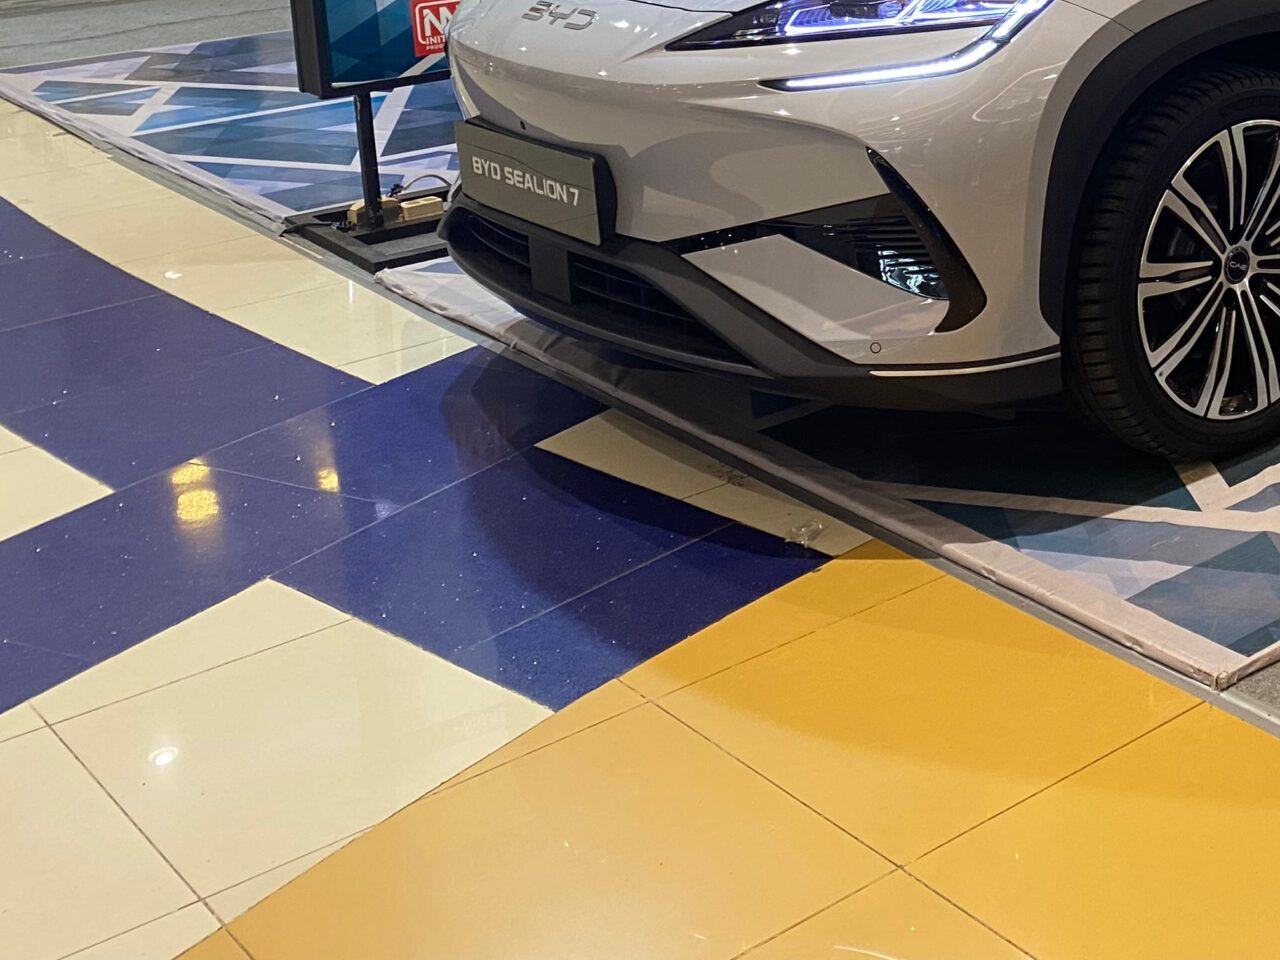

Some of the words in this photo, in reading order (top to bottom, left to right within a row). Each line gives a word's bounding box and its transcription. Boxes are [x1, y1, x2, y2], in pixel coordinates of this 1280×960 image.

[521, 0, 599, 30] BYD
[426, 35, 445, 45] INIT
[472, 156, 500, 181] BYD
[504, 166, 567, 204] SEALION
[570, 188, 579, 206] 7
